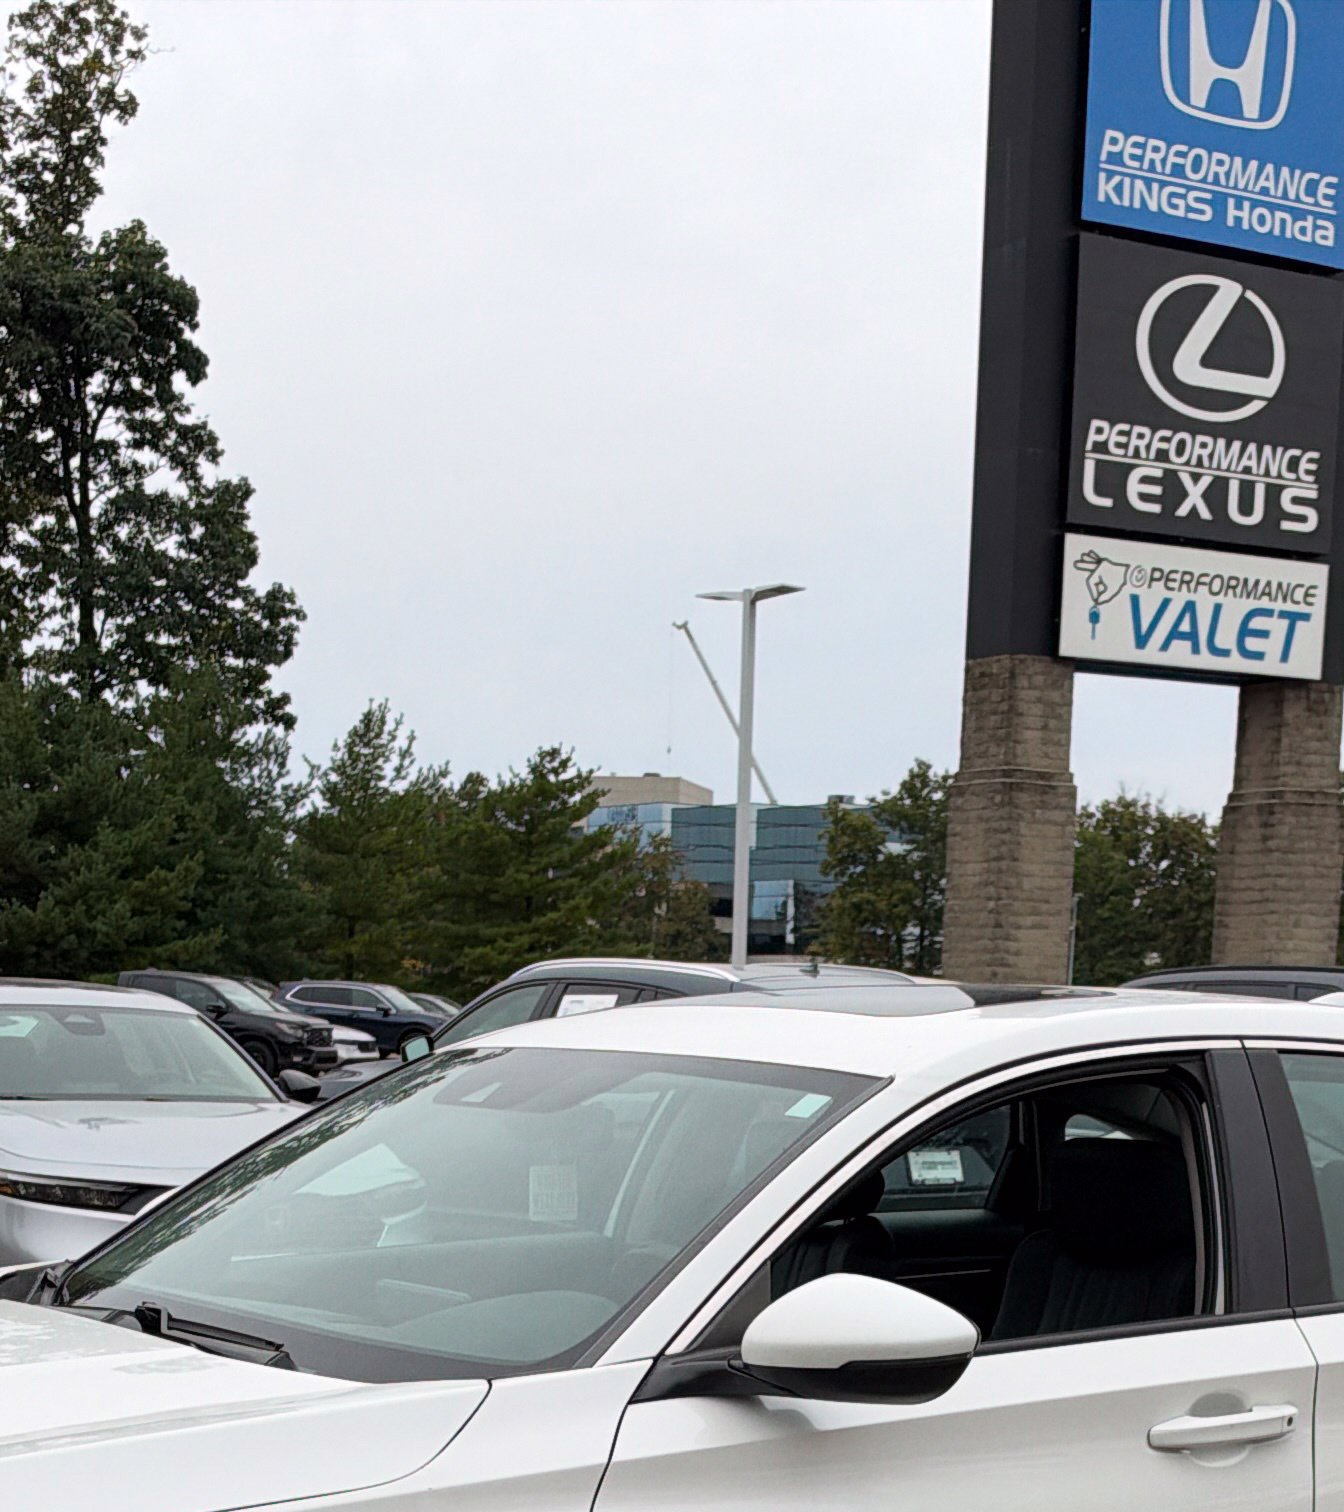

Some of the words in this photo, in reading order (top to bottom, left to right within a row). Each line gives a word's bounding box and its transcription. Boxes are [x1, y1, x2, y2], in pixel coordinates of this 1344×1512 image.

[1099, 128, 1339, 208] PERFORMANCE
[1097, 172, 1214, 222] KINGS
[1226, 197, 1336, 248] Honda
[1084, 418, 1321, 483] PERFORMANCE
[1082, 458, 1320, 534] LEXUS
[1147, 567, 1319, 607] PERFORMANCE
[1128, 593, 1313, 664] VALET
